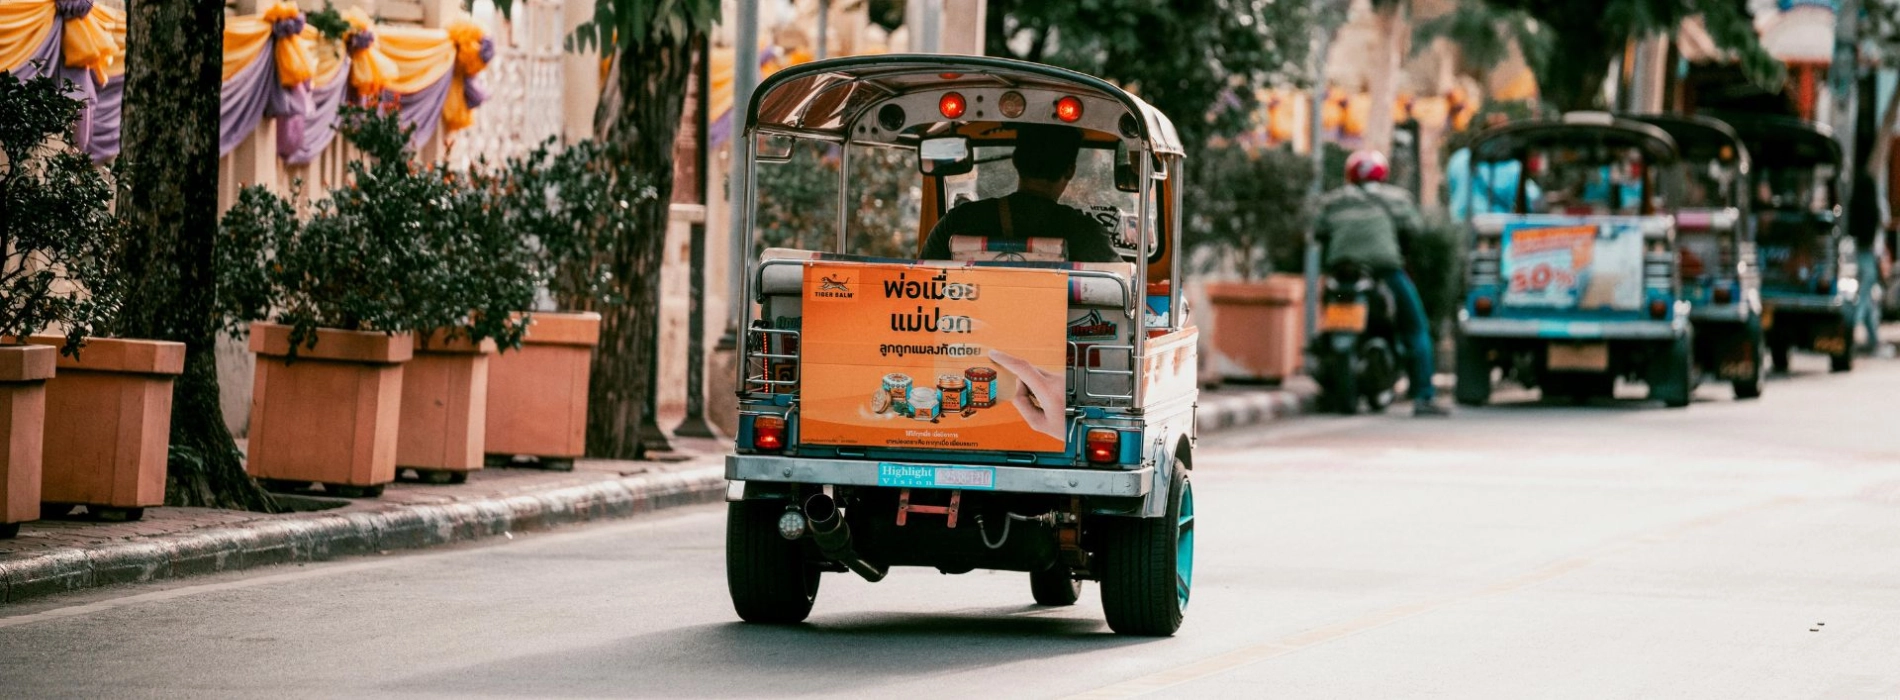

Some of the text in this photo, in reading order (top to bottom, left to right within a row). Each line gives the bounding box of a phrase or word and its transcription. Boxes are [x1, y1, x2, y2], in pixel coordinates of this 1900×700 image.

[884, 269, 980, 301] พ่อเมื่อย
[891, 306, 972, 334] แม่ปวด
[879, 343, 981, 357] ลูกถูกแมลงกัดต่อย
[882, 465, 932, 479] Highlight
[882, 478, 932, 486] Vision
